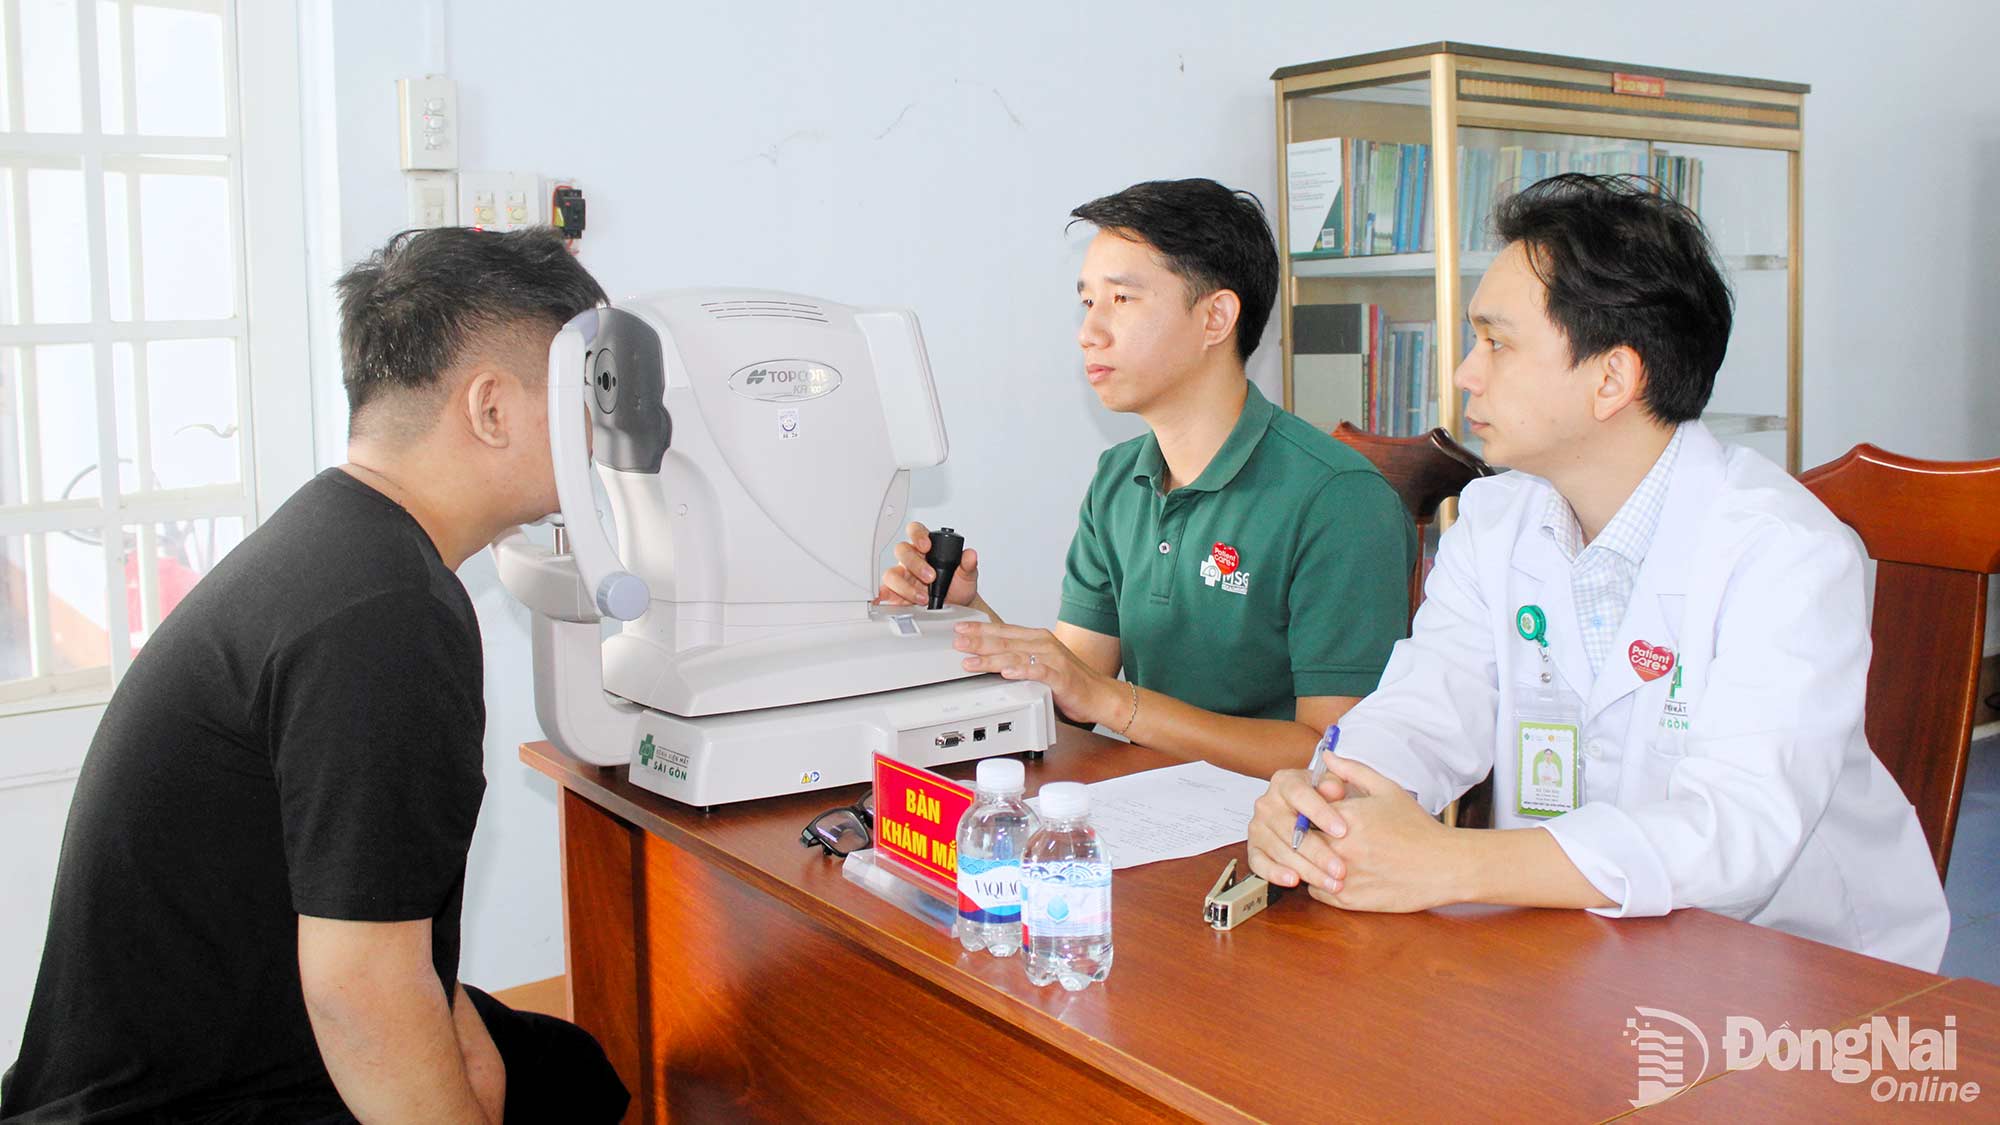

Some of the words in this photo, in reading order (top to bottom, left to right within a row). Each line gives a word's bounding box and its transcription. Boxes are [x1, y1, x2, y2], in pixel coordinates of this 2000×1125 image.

[1631, 645, 1670, 665] Patient
[669, 766, 687, 781] GÒN
[906, 788, 940, 824] BÀN
[882, 816, 927, 859] KHÁM
[932, 840, 957, 874] MẮ
